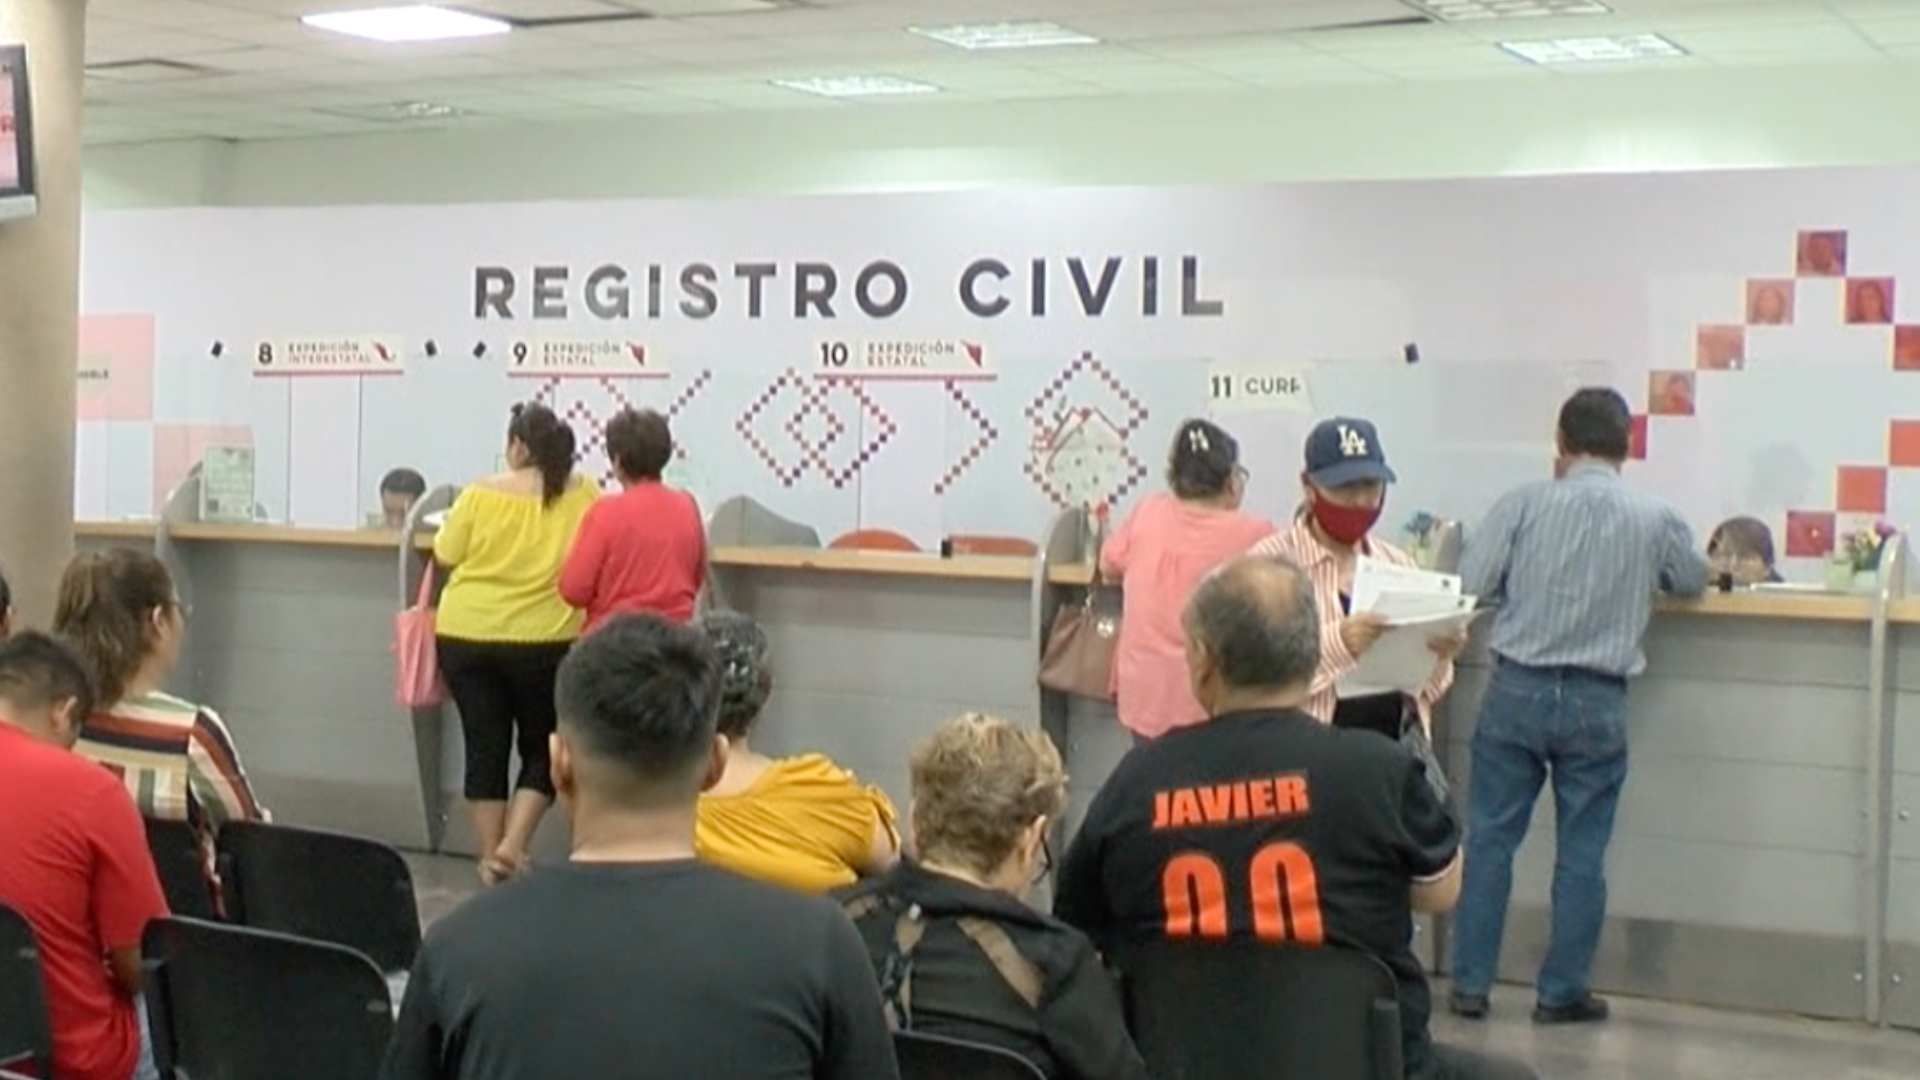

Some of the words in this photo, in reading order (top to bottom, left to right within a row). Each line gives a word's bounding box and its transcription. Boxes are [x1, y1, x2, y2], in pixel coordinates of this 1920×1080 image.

[474, 260, 909, 319] REGISTRO
[959, 256, 1226, 318] CIVIL
[258, 342, 273, 364] 8
[513, 341, 528, 365] 9
[821, 342, 848, 367] 10
[868, 340, 955, 354] EXPEDICIÓN
[544, 354, 594, 366] ESTATAL
[867, 355, 926, 367] ESTATAL
[1211, 375, 1232, 399] 11
[1338, 425, 1368, 456] LA
[1152, 775, 1310, 829] JAVIER
